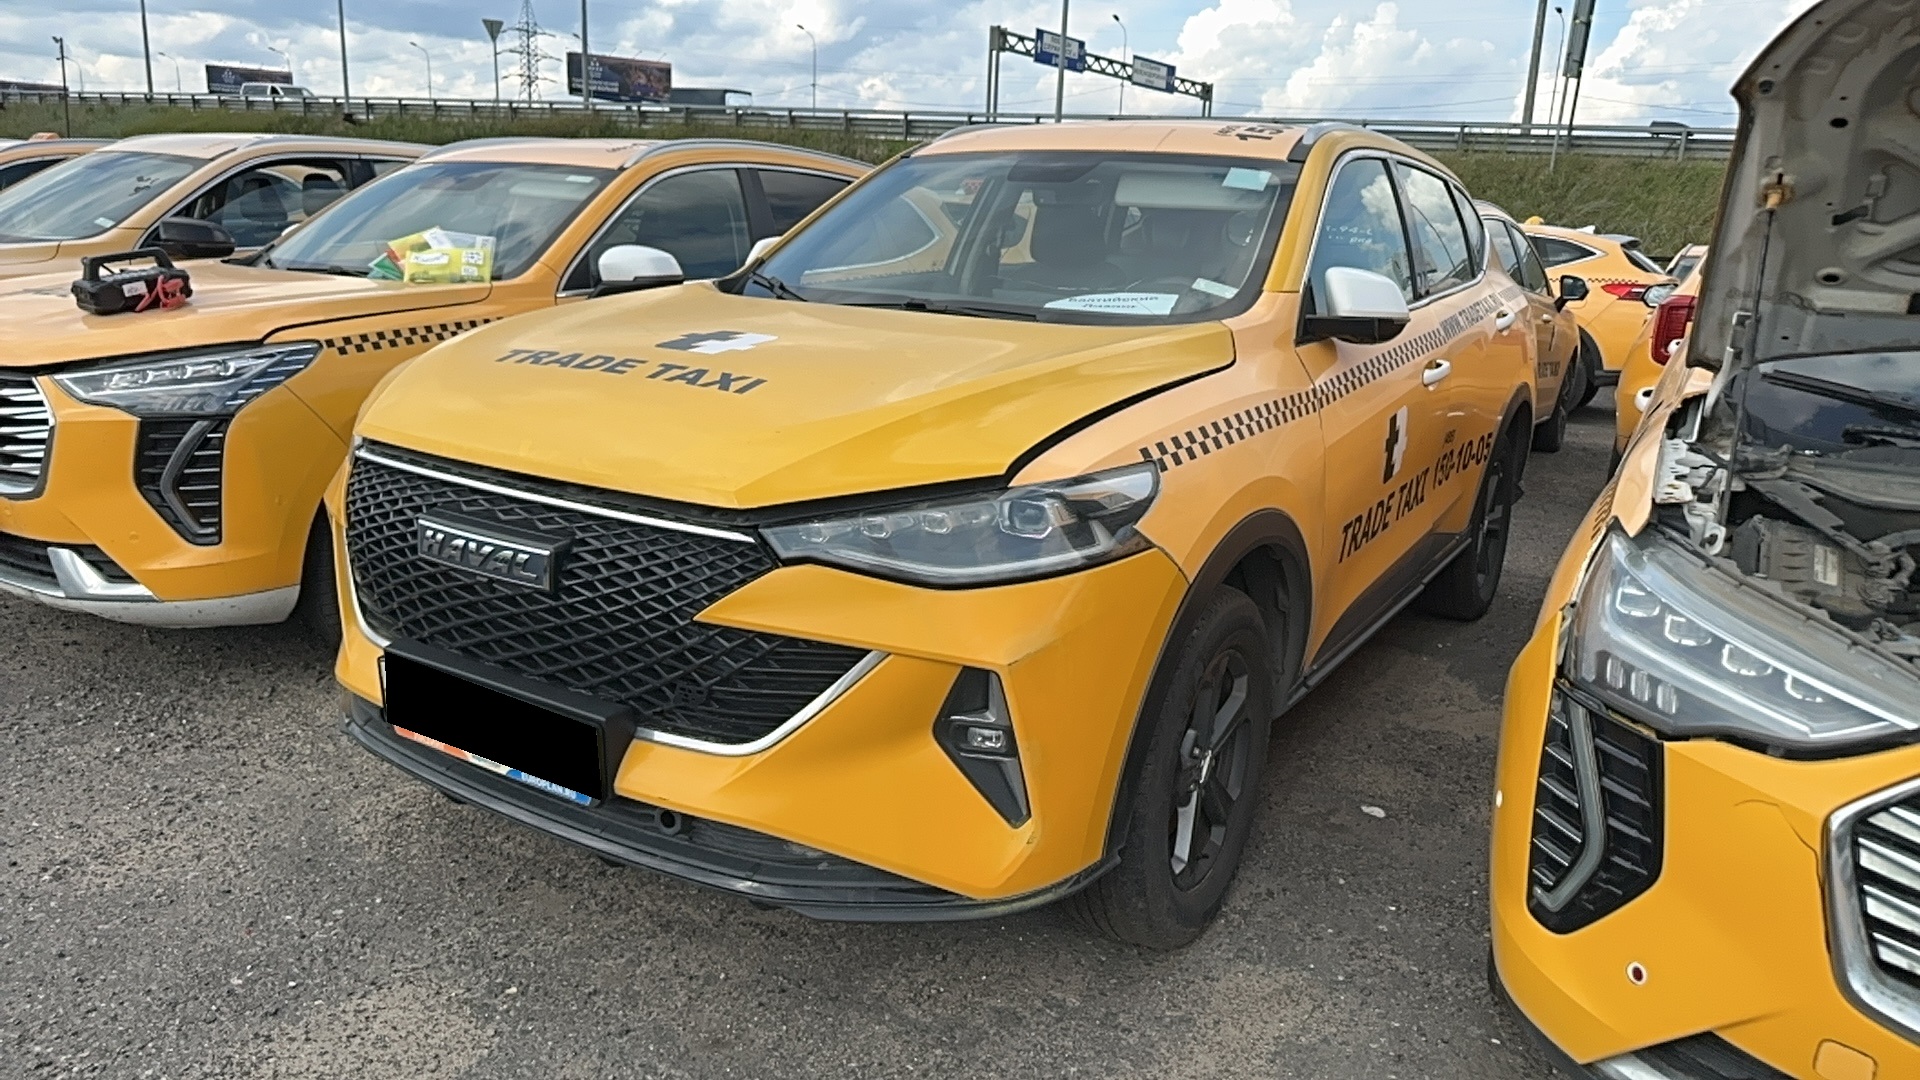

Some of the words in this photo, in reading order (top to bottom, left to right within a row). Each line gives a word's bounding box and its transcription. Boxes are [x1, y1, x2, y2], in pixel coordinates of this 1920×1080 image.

[495, 348, 648, 374] TRADE
[645, 362, 768, 395] TAXI
[1338, 491, 1396, 564] TRADE
[1395, 466, 1430, 521] TAXI
[1433, 432, 1493, 490] 150-10-05
[422, 529, 537, 580] HAVAL
